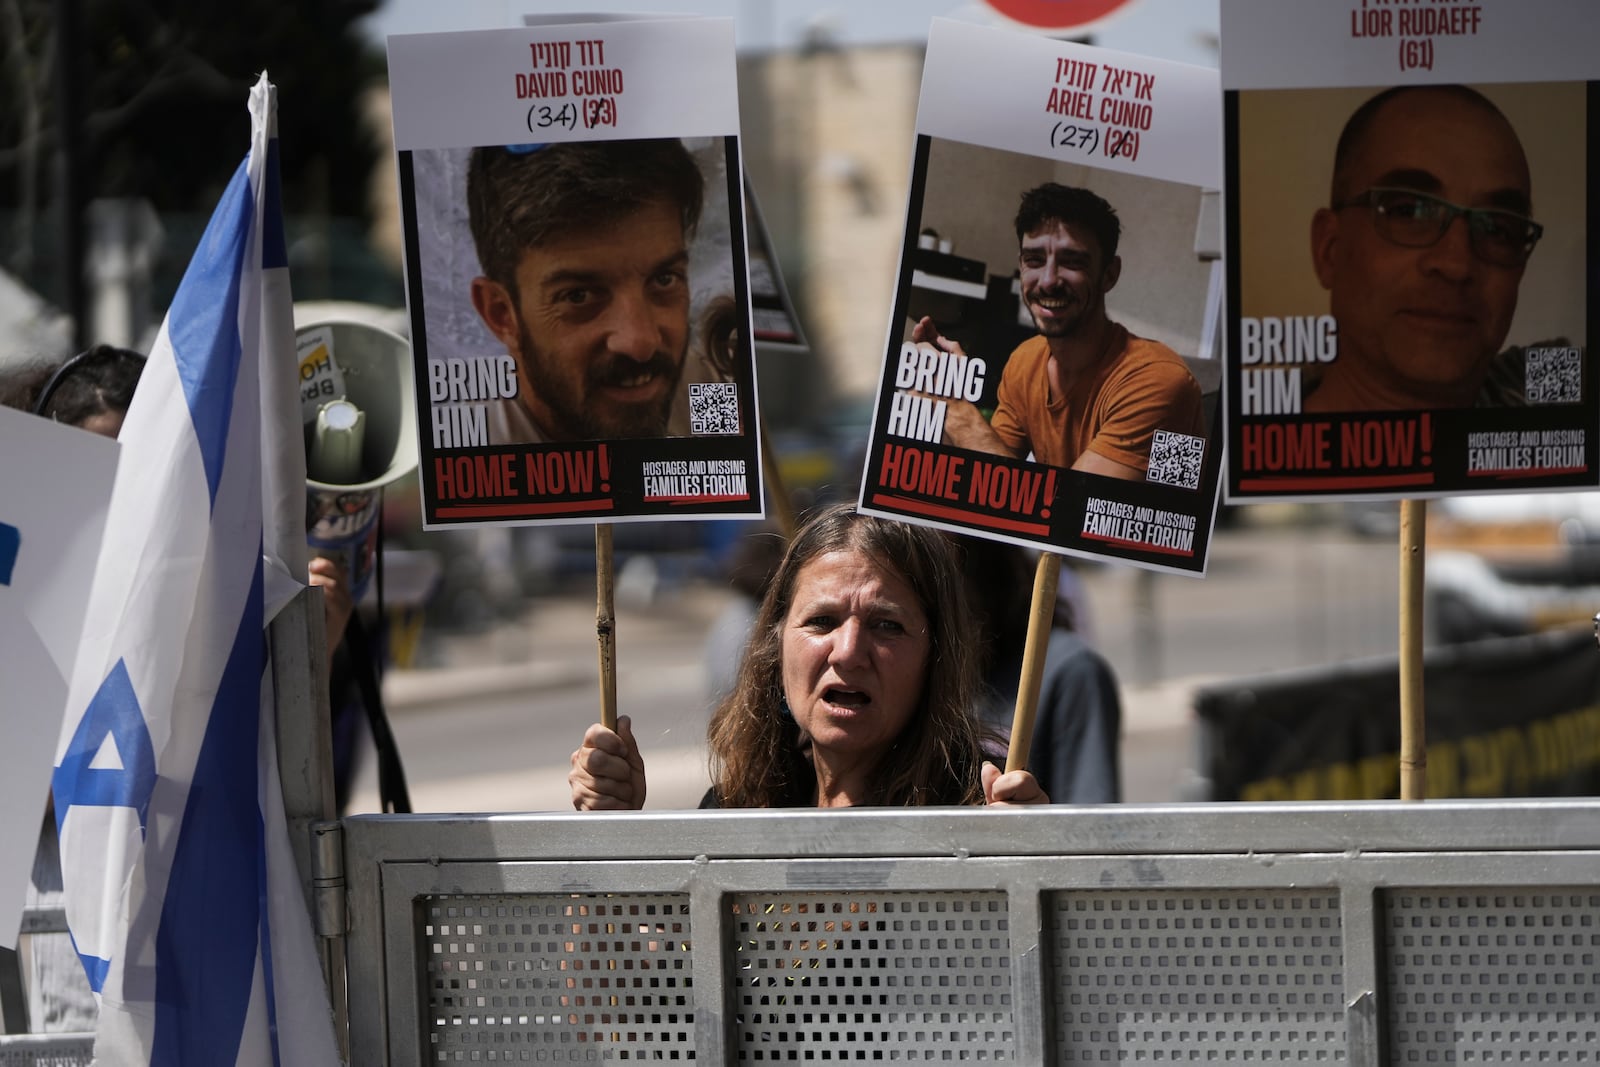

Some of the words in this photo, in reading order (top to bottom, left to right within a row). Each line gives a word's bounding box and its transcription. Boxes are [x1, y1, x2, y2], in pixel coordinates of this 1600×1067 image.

[1351, 8, 1393, 38] LIOR
[1399, 6, 1482, 36] RUDAEFF
[529, 41, 571, 70] קוניו
[575, 40, 604, 66] דוד
[1399, 38, 1434, 72] (61)
[515, 71, 567, 99] DAVID
[572, 68, 623, 96] CUNIO
[1055, 57, 1097, 92] קוניו
[1101, 64, 1155, 101] אריאל
[527, 102, 577, 133] (34)
[1045, 87, 1094, 121] ARIEL
[1099, 96, 1153, 131] CUNIO
[1050, 121, 1099, 155] (27)
[1241, 314, 1338, 365] BRING
[428, 354, 518, 402] BRING
[895, 341, 987, 402] BRING
[1241, 367, 1301, 416] HIM
[432, 404, 489, 449] HIM
[887, 391, 947, 444] HIM
[1242, 423, 1331, 471] HOME
[1340, 412, 1432, 469] NOW!
[1467, 431, 1519, 448] HOSTAGES
[1520, 430, 1540, 447] AND
[1541, 429, 1585, 446] MISSING
[435, 454, 518, 500] HOME
[525, 443, 612, 496] NOW!
[643, 461, 687, 476] HOSTAGES
[689, 460, 706, 475] AND
[707, 460, 746, 475] MISSING
[1468, 447, 1532, 471] FAMILIES
[1535, 445, 1585, 469] FORUM
[643, 475, 700, 497] FAMILIES
[702, 474, 747, 496] FORUM
[879, 443, 965, 501] HOME
[968, 461, 1057, 519] NOW!
[1086, 497, 1134, 519] HOSTAGES
[1133, 506, 1154, 523] AND
[1154, 509, 1196, 531] MISSING
[1083, 512, 1144, 543] FAMILIES
[1145, 523, 1194, 552] FORUM
